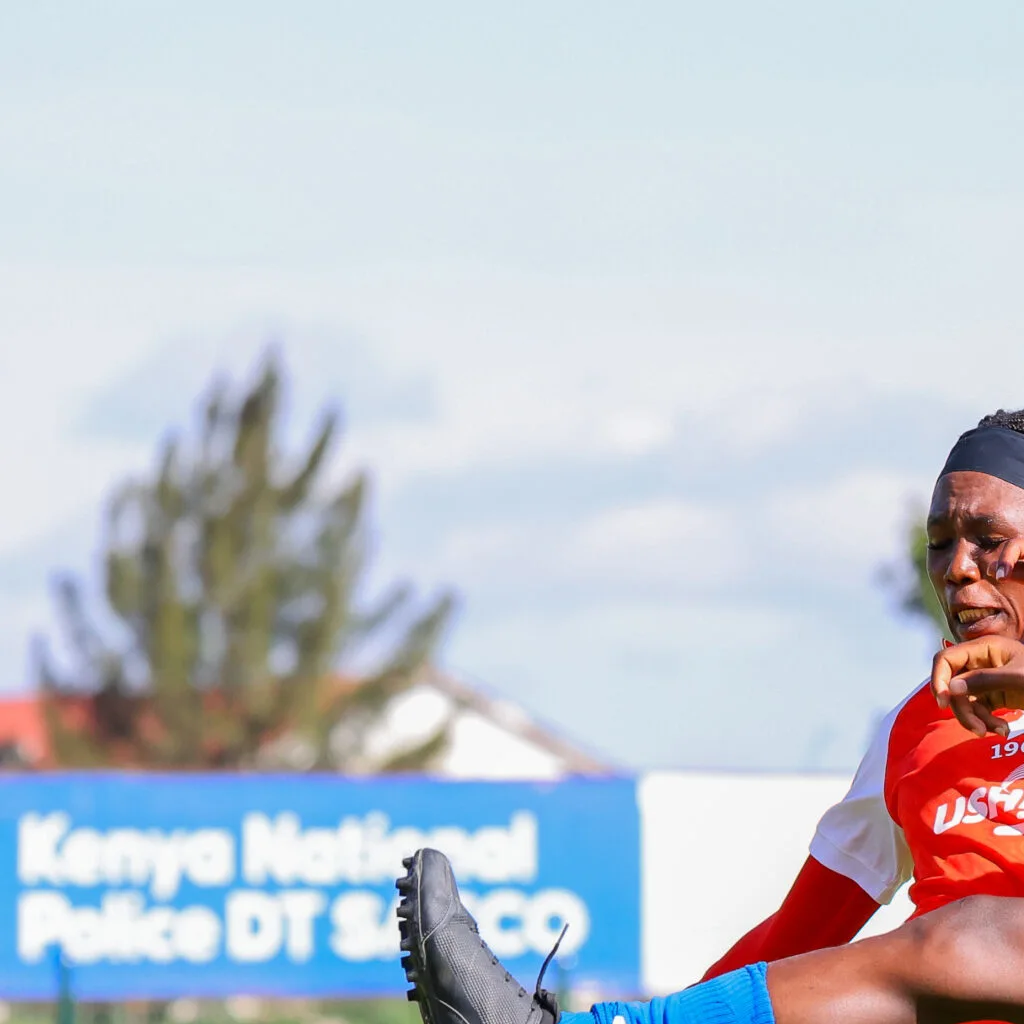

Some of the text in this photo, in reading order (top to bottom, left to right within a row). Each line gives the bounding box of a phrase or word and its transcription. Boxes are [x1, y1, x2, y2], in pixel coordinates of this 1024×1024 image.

[17, 809, 539, 899] Kenya National
[17, 888, 590, 964] Police DT SCO
